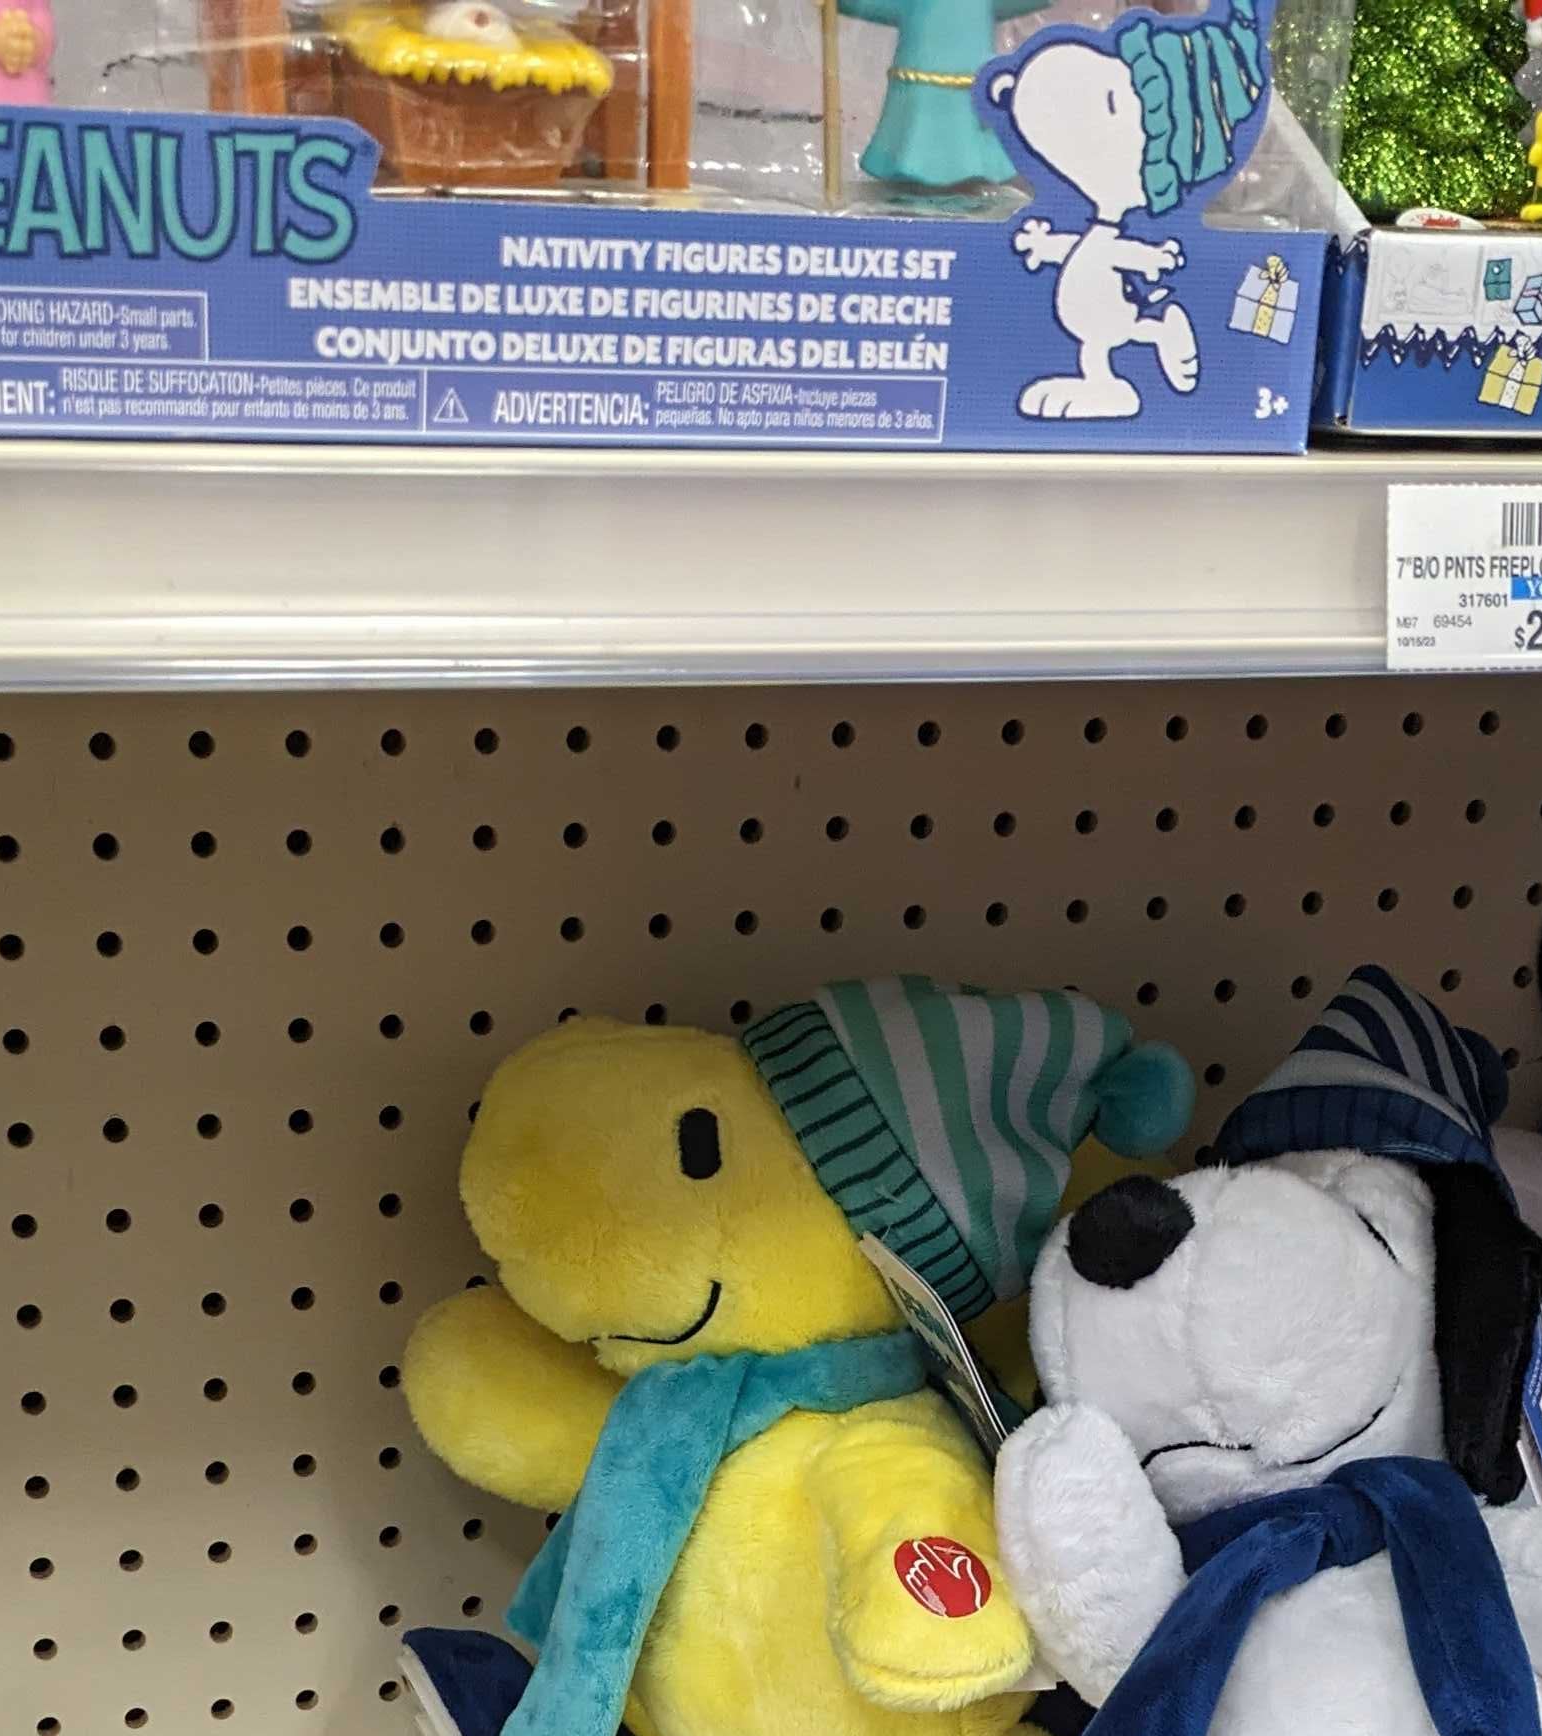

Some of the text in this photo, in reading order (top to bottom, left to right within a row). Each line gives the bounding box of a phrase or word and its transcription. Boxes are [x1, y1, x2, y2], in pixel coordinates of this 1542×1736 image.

[499, 235, 957, 279] NATIVITY FIGURES DELUXE SET
[288, 278, 952, 326] ENSEMBLE DE LUXE DE FIGURINES DE CRECHE
[160, 307, 197, 330] parts.
[1, 327, 18, 345] for
[23, 327, 75, 349] children
[80, 331, 116, 349] under
[119, 332, 130, 349] 3
[133, 334, 170, 352] years.
[316, 326, 948, 371] CONJUNTO DELUXE DE FIGURAS DEL BELÉN
[493, 391, 650, 426] ADVERTENCIA:
[1254, 387, 1289, 419] 3+
[1444, 556, 1485, 579] PNTS
[1458, 592, 1509, 609] 317601
[1433, 614, 1473, 629] 69454
